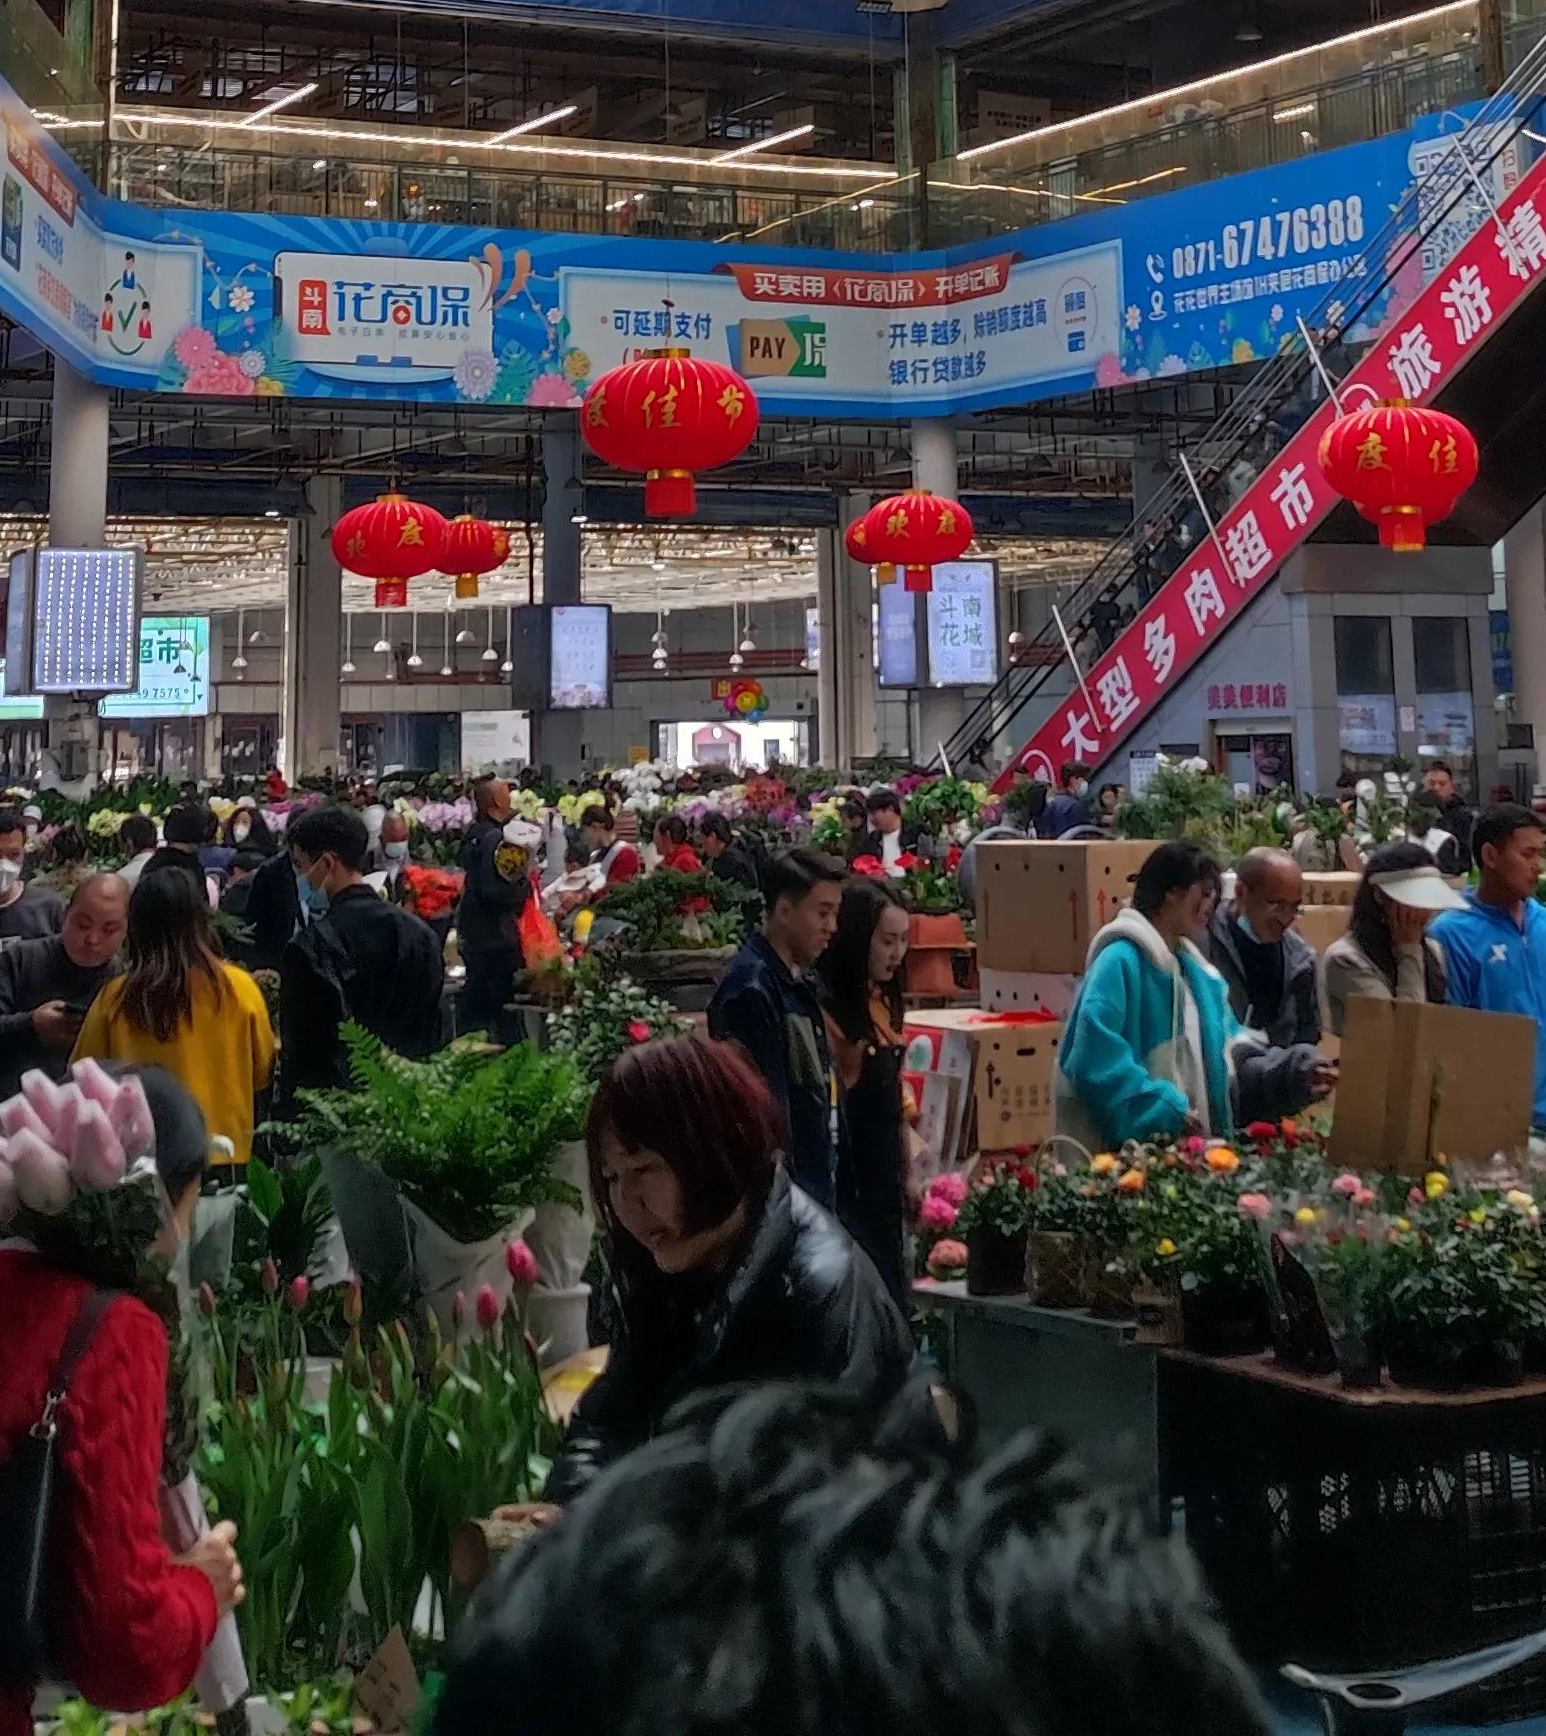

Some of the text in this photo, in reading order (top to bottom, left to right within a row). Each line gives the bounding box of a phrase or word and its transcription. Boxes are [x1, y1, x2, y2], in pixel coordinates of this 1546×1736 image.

[1171, 194, 1365, 280] 0871-67476388
[301, 285, 324, 331] 斗南
[332, 280, 471, 328] 花商保
[612, 308, 713, 341] 可延期支付
[749, 335, 786, 359] PAY
[888, 350, 987, 387] 银行贷款越多
[938, 594, 982, 619] 斗南
[1058, 462, 1317, 762] 大型多肉超市
[940, 623, 985, 648] 花城
